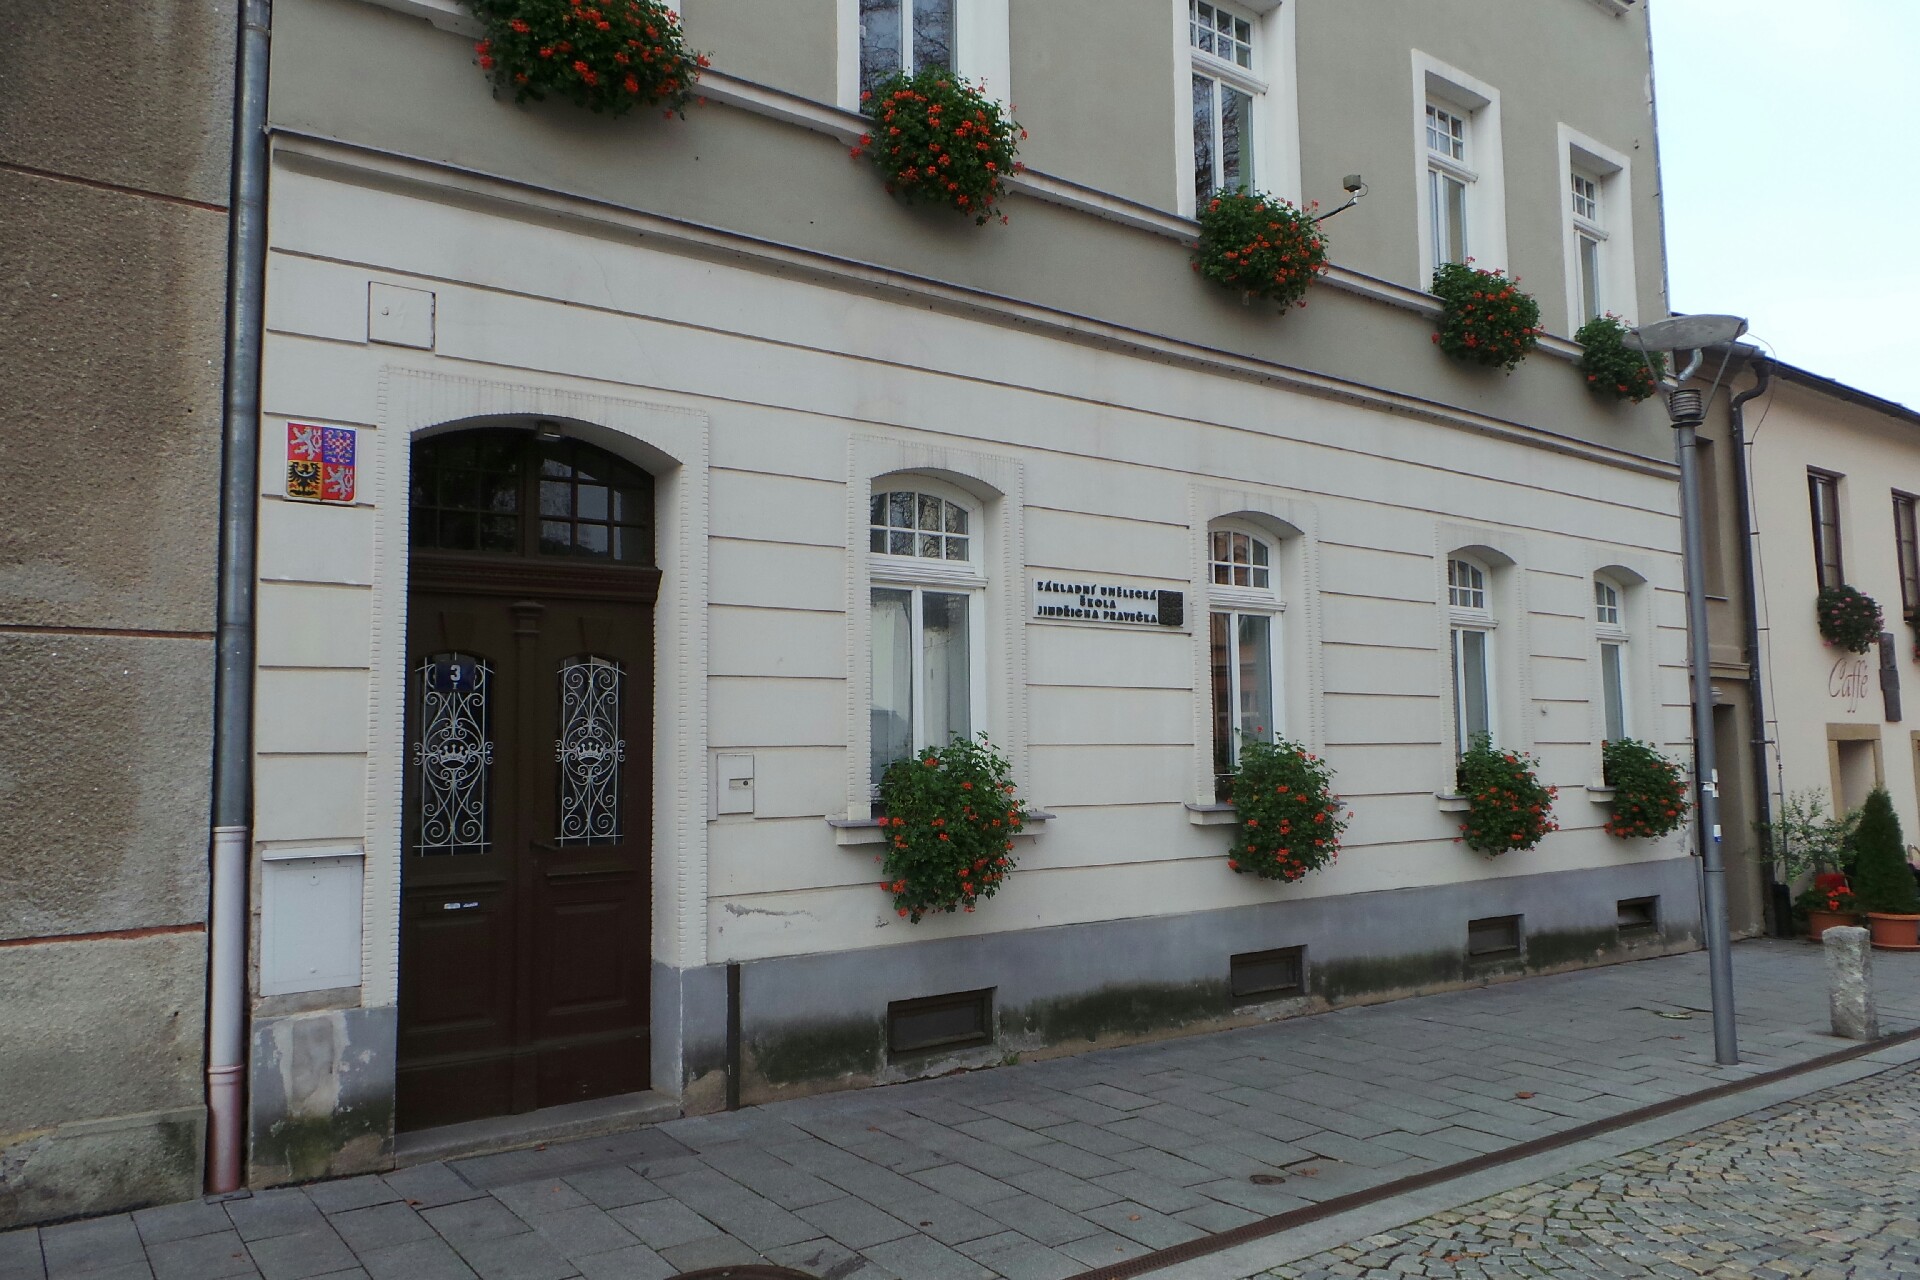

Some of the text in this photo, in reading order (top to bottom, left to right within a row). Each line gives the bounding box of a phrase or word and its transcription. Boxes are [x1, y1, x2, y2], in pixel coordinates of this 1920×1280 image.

[1037, 580, 1157, 600] ZÁKLADNÍ UMĚLECKÁ
[1079, 594, 1117, 609] ŠKOLA
[1037, 605, 1158, 623] JINDŘICHA PRAVEČKA
[450, 664, 461, 681] 3
